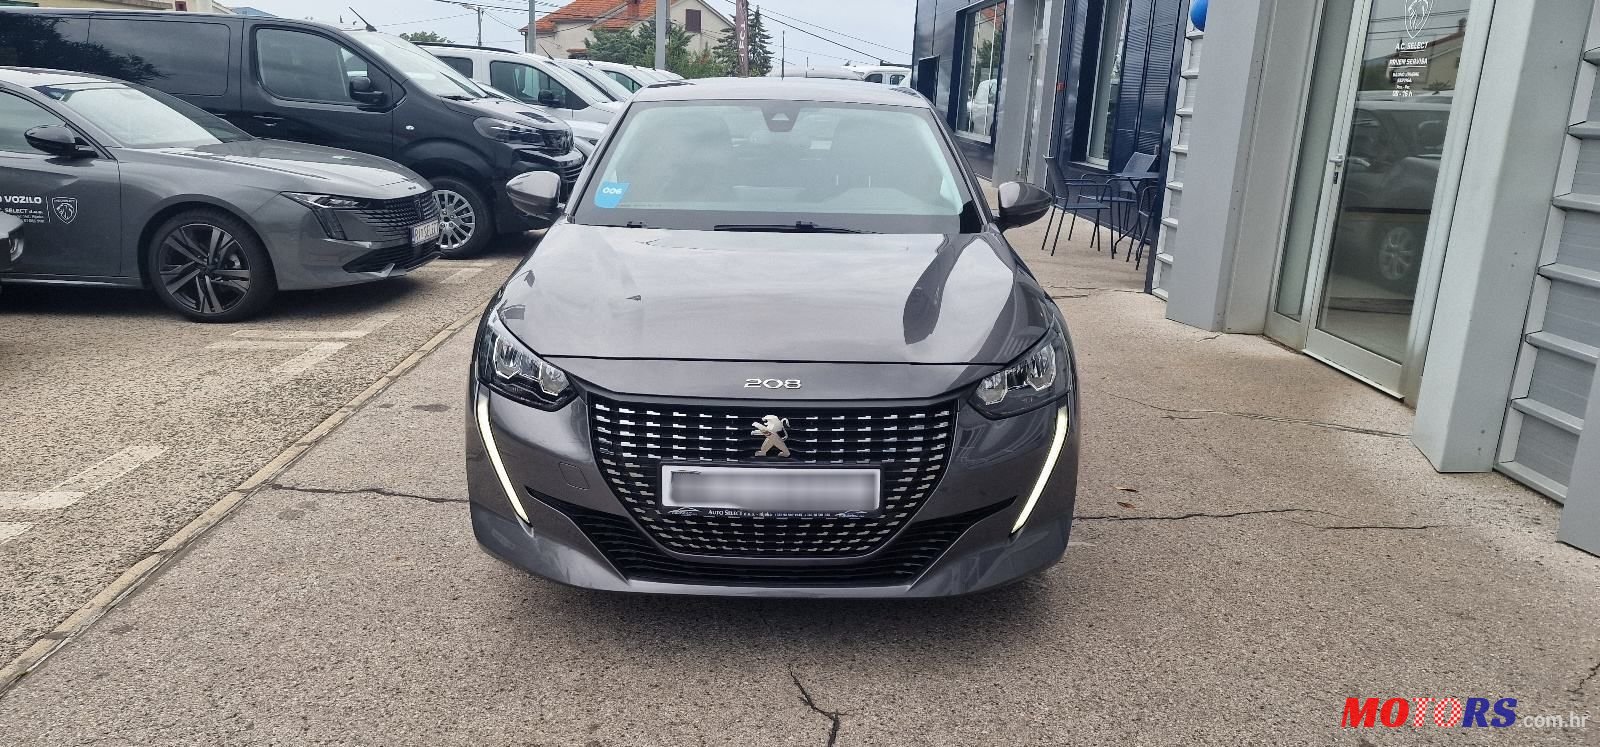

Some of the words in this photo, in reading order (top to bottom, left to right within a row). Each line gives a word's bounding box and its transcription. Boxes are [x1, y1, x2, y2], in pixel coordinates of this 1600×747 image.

[1406, 41, 1429, 50] SELECT
[4, 195, 42, 204] VOZILO
[743, 378, 802, 389] 208
